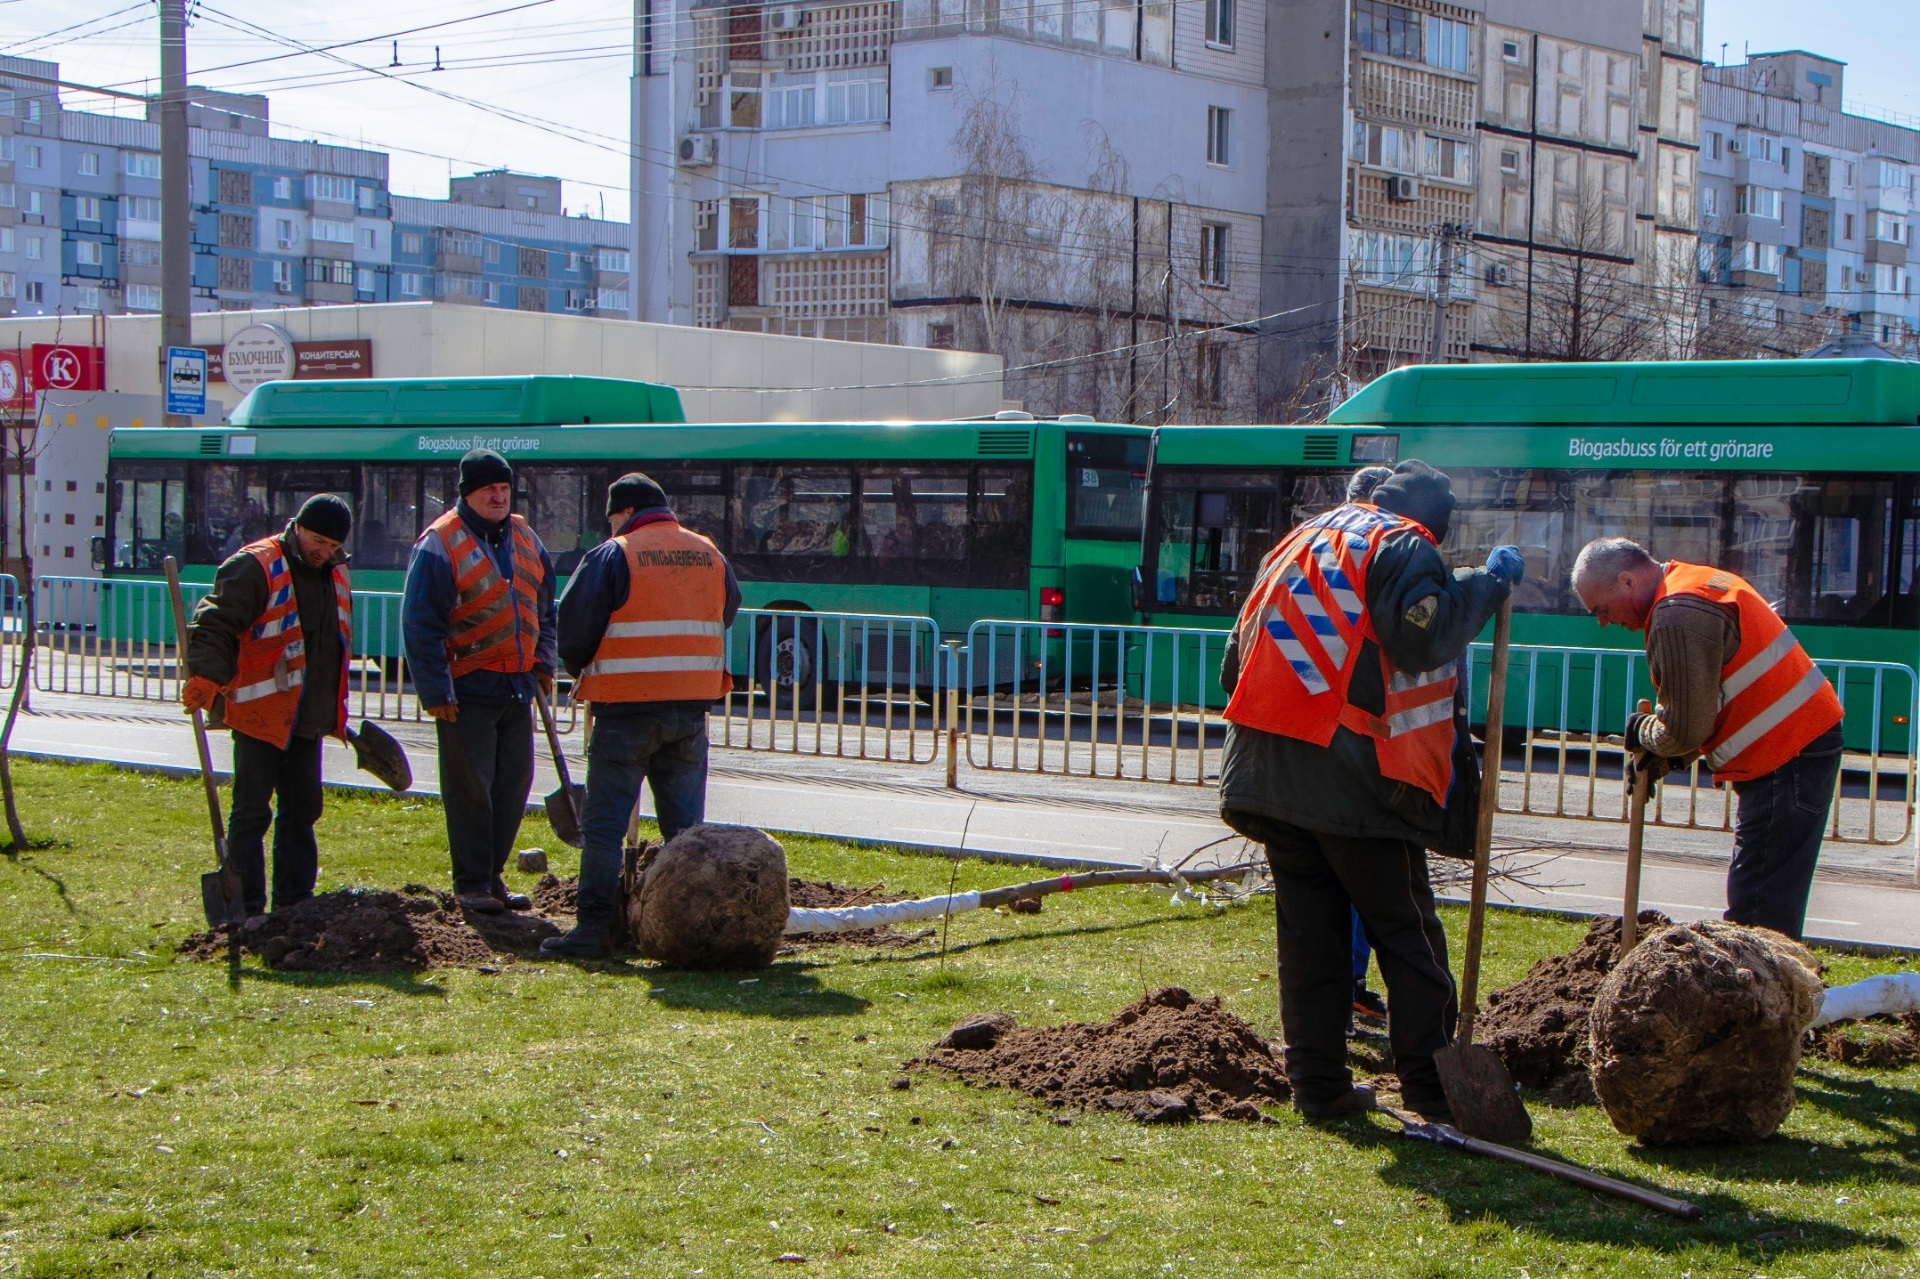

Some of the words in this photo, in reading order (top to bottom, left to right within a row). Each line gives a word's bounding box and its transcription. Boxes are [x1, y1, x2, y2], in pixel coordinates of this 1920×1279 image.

[229, 351, 285, 366] БУЛОЧНИК
[300, 350, 361, 360] КОНДИТЕРСЬКА
[418, 436, 471, 453] Biogasbuss
[473, 436, 487, 450] för
[487, 438, 501, 450] ett
[502, 437, 540, 453] grönare
[1569, 438, 1656, 460] Biogasbuss
[1659, 438, 1682, 457] för
[1684, 441, 1708, 458] ett
[1710, 440, 1774, 462] grönare
[1084, 472, 1097, 483] 38
